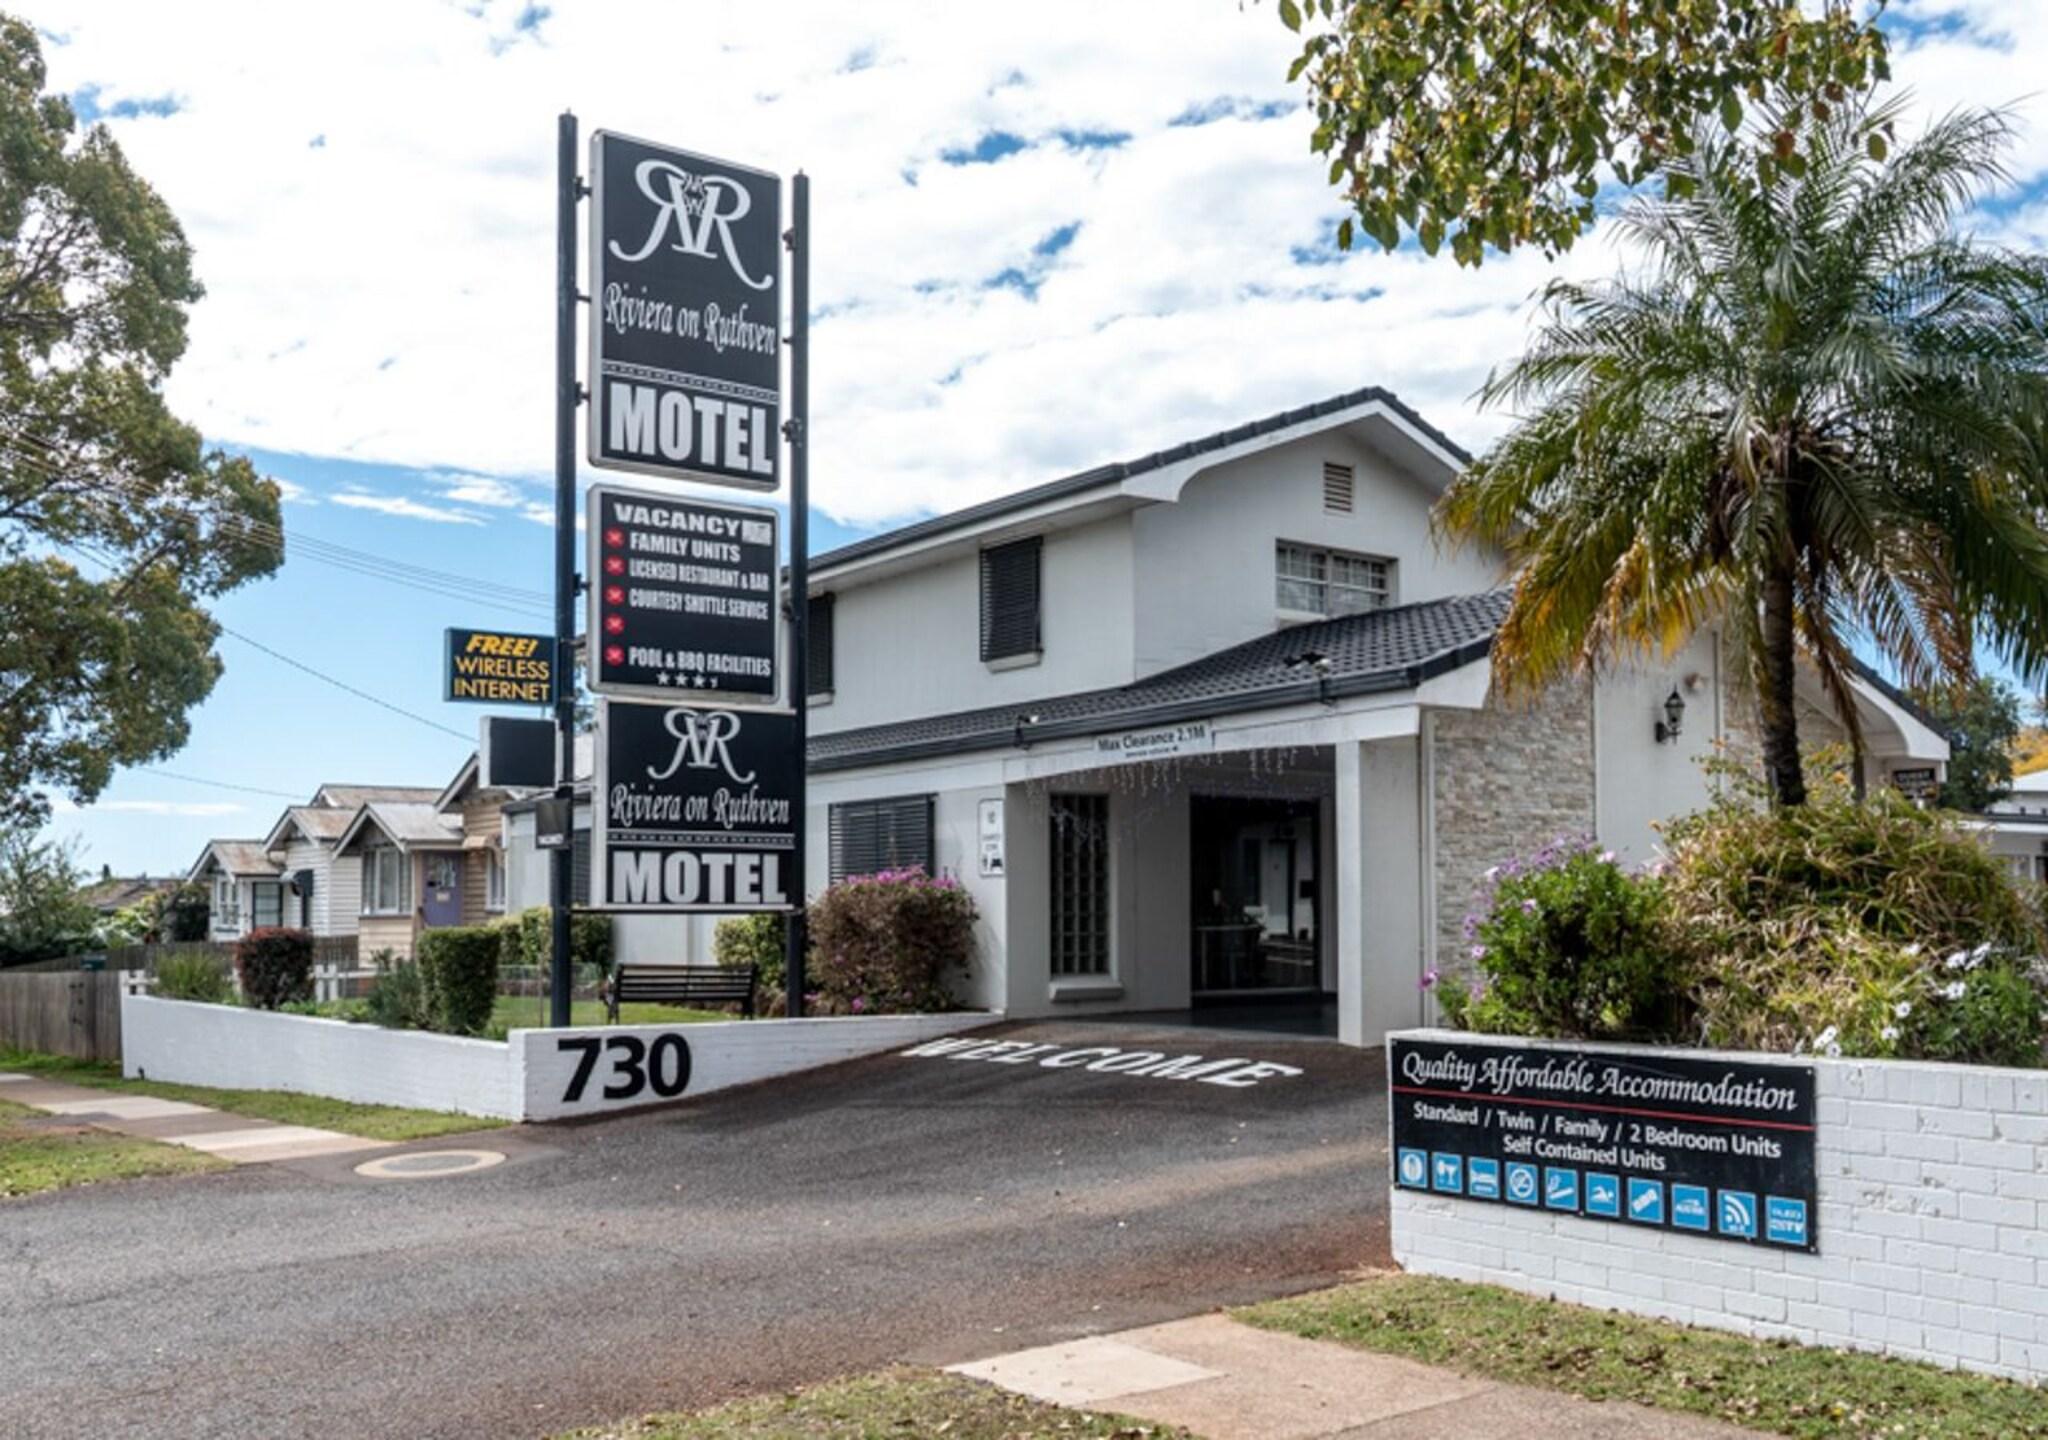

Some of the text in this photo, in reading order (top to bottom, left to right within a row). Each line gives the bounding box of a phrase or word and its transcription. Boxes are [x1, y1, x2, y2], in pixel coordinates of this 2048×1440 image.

[604, 282, 775, 355] Riviera on Ruthven
[610, 382, 774, 475] MOTEL
[613, 503, 740, 536] VACANCY
[630, 532, 741, 562] FAMILY UNITS
[629, 558, 769, 592] LICENSED RESTAURANT & BAR
[629, 588, 769, 620] COURTESY SHUTTLE SERVICE
[466, 634, 539, 657] FREE!
[629, 646, 771, 677] POOL & BBQ FACILITIES
[455, 656, 550, 680] WIRELESS
[454, 678, 550, 702] INTERNET
[610, 783, 790, 829] Riviera on Ruthven
[613, 851, 787, 905] MOTEL
[557, 1032, 692, 1101] 730
[900, 1036, 1304, 1087] WELCOME
[1402, 1051, 1798, 1112] Quality Affordable Accommodation
[1413, 1101, 1479, 1125] Standard
[1497, 1109, 1535, 1131] Twin
[1555, 1116, 1608, 1143] Family
[1630, 1123, 1641, 1143] 2
[1645, 1125, 1727, 1152] Bedroom
[1731, 1134, 1781, 1158] Units
[1503, 1134, 1666, 1171] Self Contained Units
